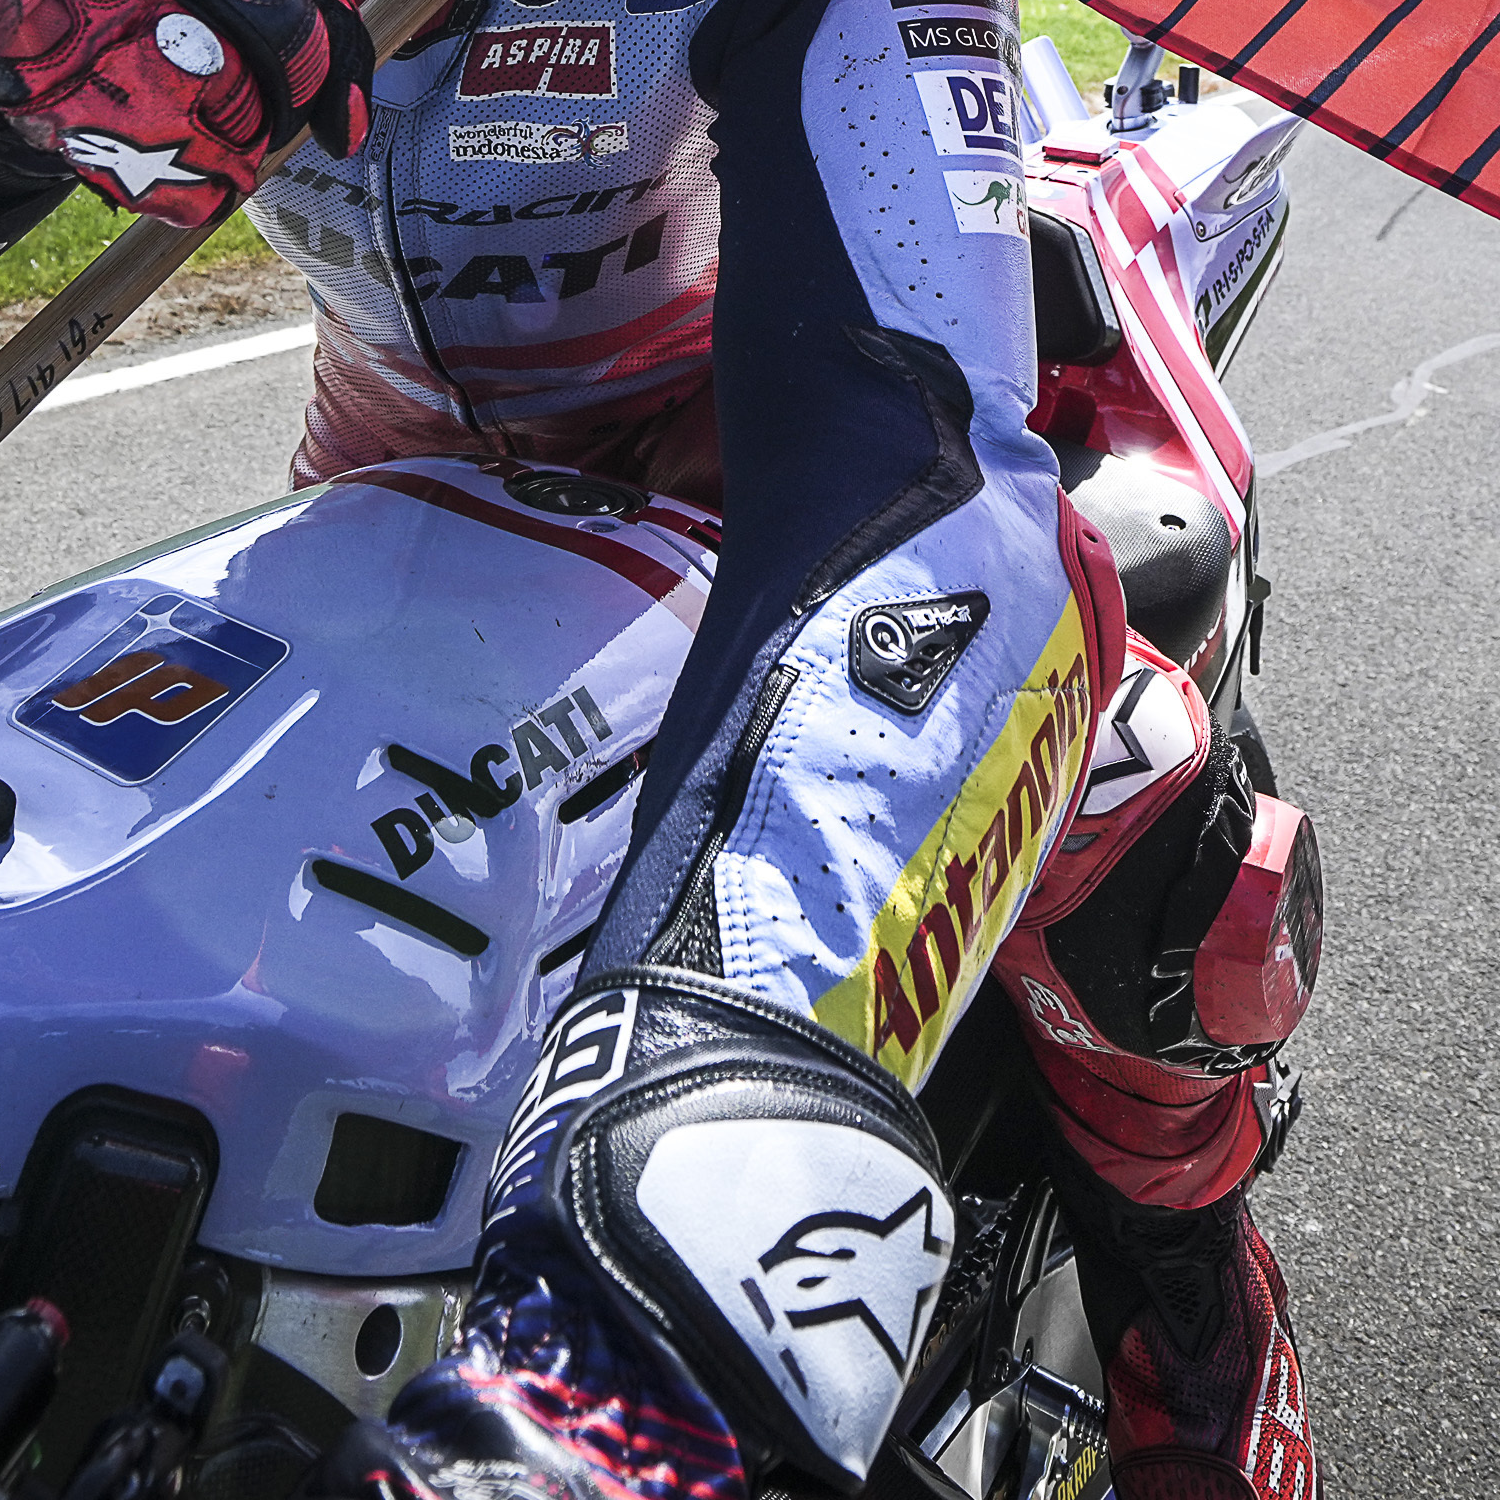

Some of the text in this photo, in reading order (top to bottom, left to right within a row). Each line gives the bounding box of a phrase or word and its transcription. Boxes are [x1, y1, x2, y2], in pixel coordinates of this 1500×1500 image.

[480, 37, 601, 70] ASPIRA
[453, 126, 534, 142] wonderful
[453, 140, 562, 161] indonesia
[260, 206, 668, 303] UCATI
[8, 362, 56, 417] 417
[370, 685, 613, 881] DUCATI
